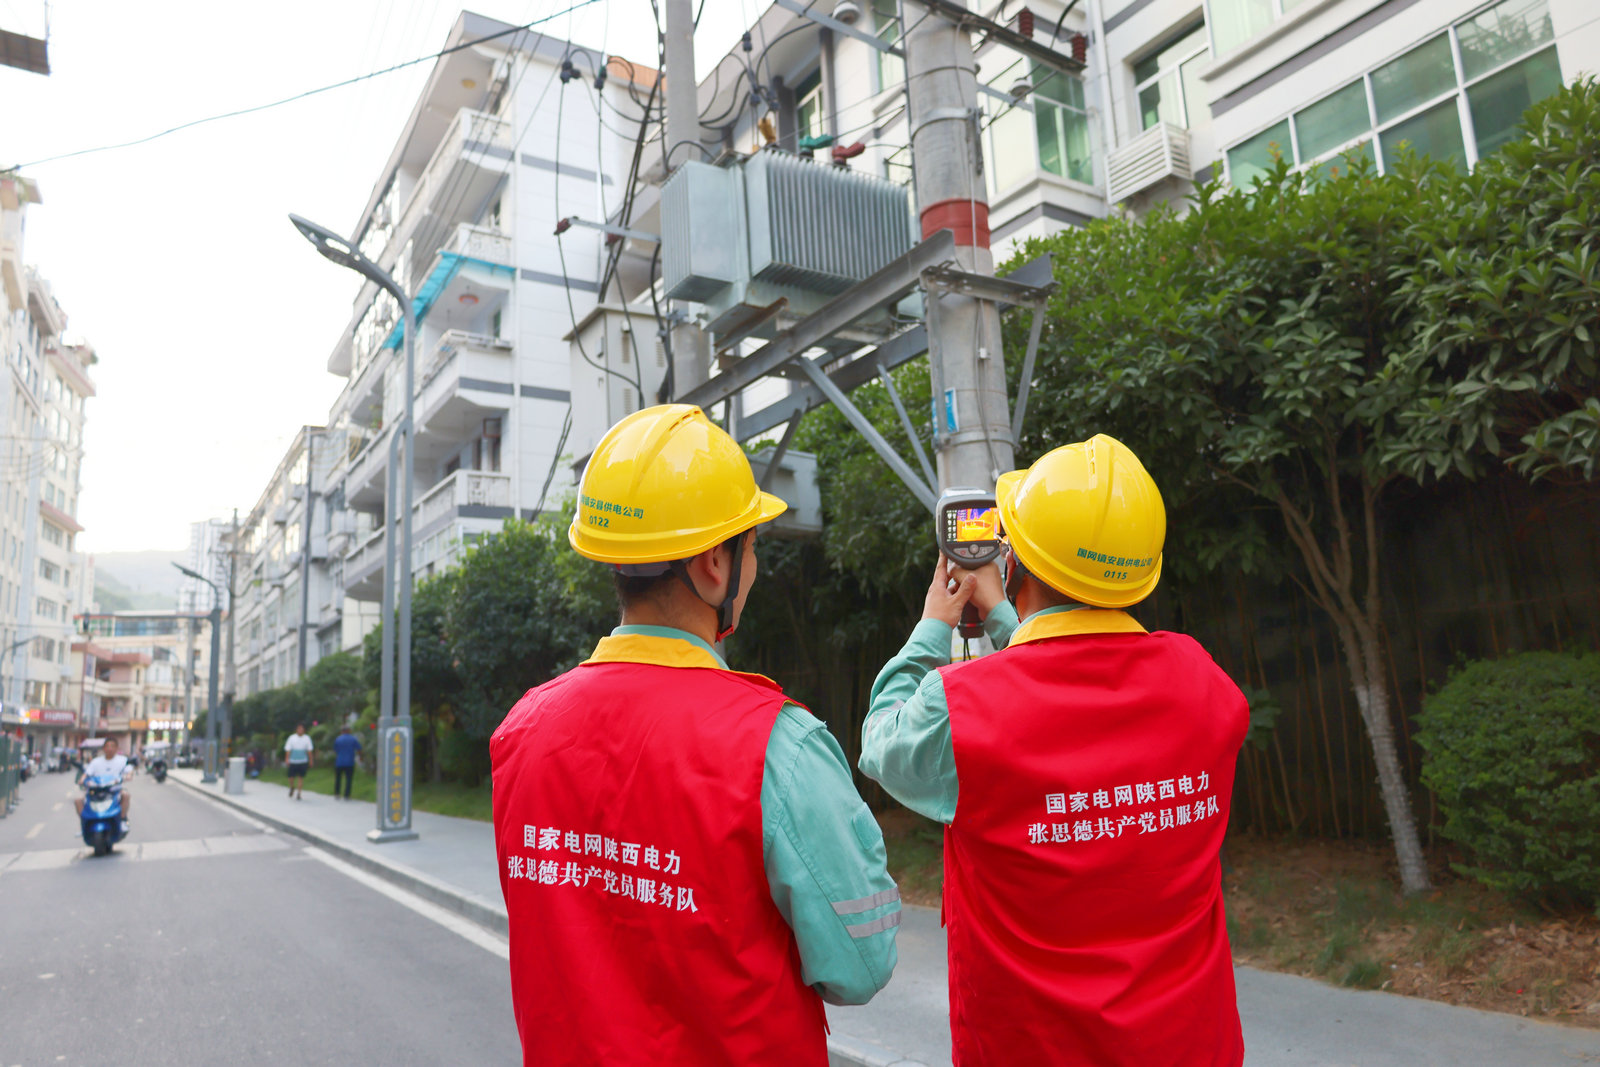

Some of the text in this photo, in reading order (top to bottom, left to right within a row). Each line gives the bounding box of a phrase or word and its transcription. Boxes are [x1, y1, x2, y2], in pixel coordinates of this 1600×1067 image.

[589, 515, 610, 528] 0122
[1077, 547, 1153, 567] 国网镇安县供电公司
[1104, 570, 1128, 580] 0115
[1045, 770, 1210, 814] 国家电网陕西电力
[1028, 795, 1220, 844] 张思德共产党员服务队
[523, 824, 681, 875] 国家电网陕西电力
[508, 855, 699, 914] 张思德共产党员服务队
